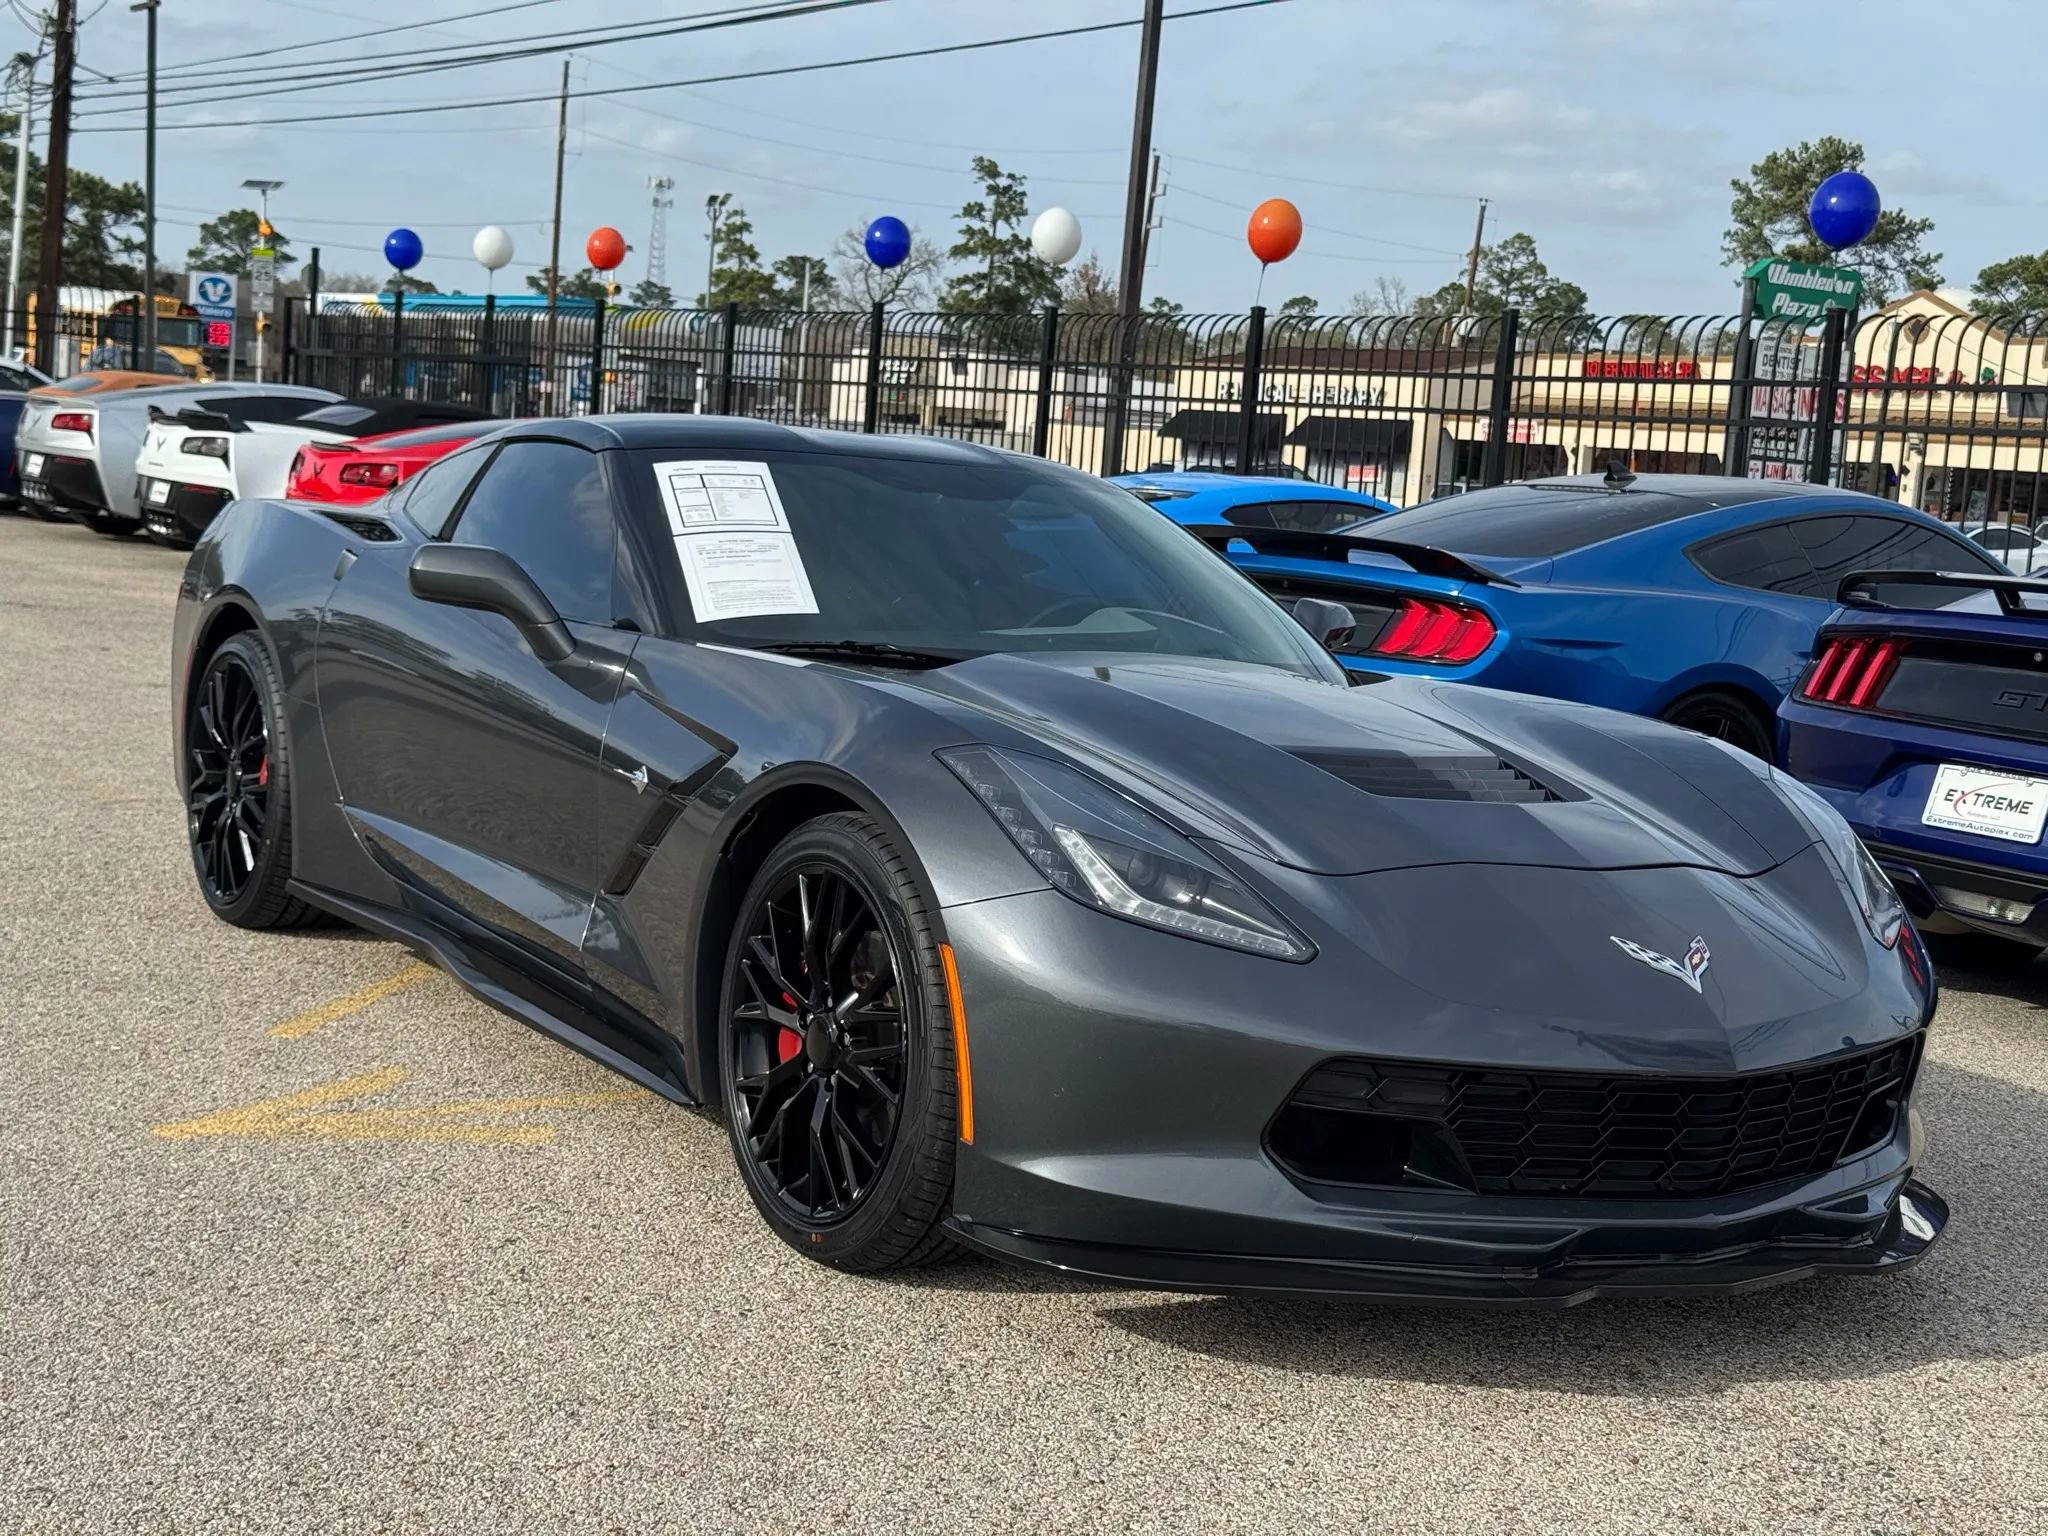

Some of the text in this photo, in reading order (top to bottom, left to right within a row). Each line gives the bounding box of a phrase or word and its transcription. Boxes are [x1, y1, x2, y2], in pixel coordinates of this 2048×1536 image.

[1768, 263, 1856, 295] Wimbledon
[1772, 292, 1820, 318] Plaza
[1992, 691, 2048, 712] GT
[1944, 788, 2034, 815] EXTREME
[1925, 815, 2034, 841] ExtremeAutoplex.com
